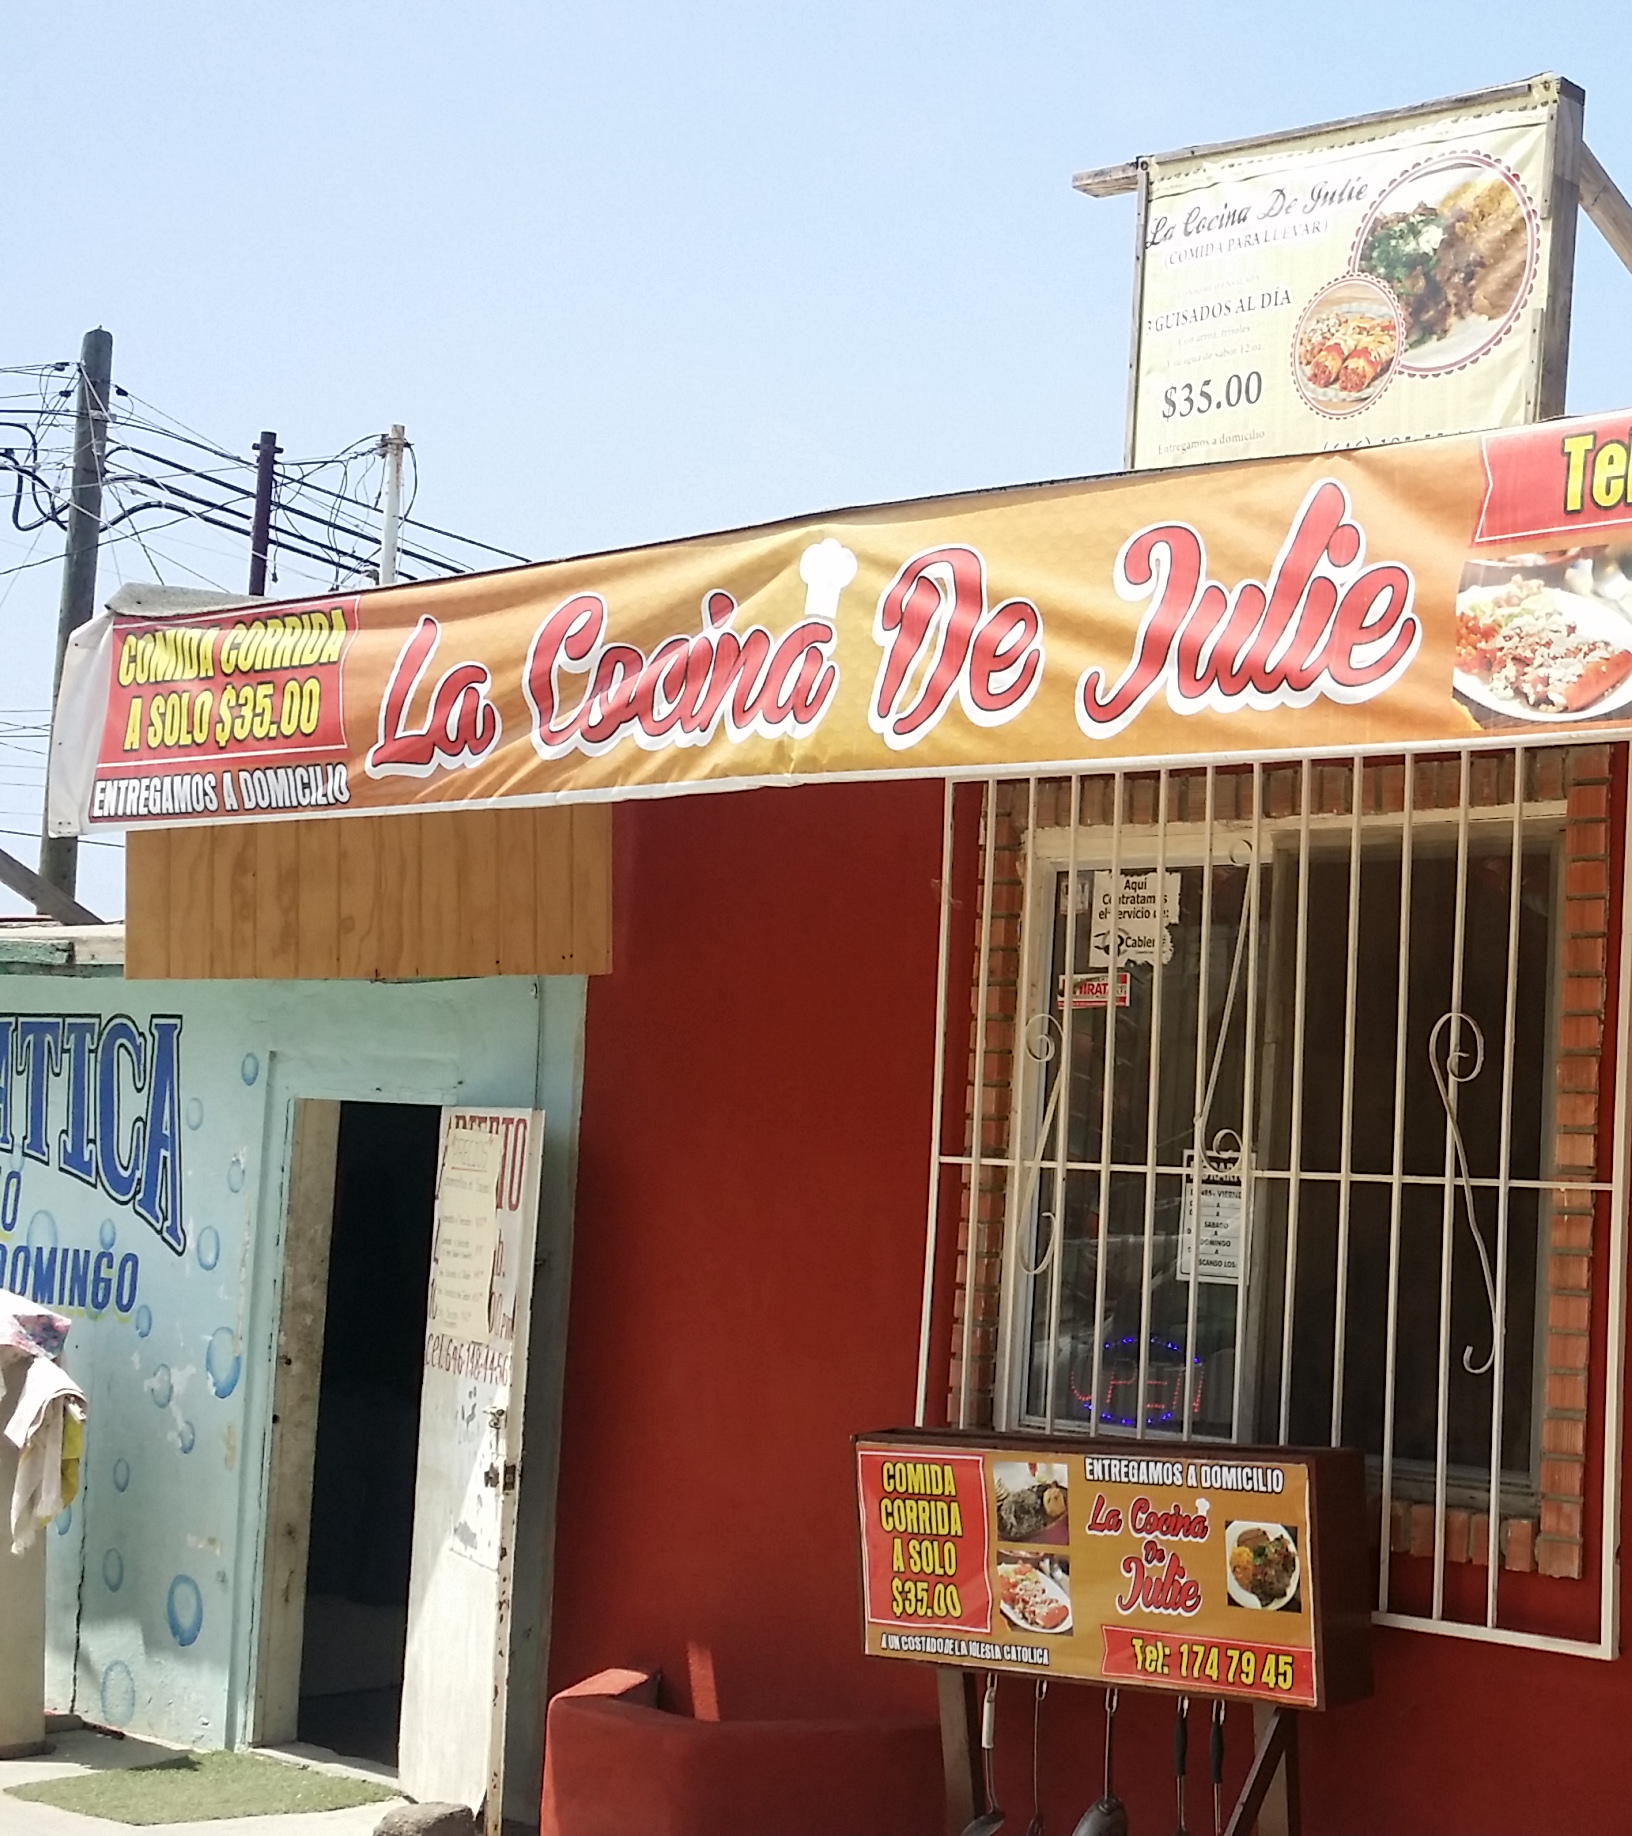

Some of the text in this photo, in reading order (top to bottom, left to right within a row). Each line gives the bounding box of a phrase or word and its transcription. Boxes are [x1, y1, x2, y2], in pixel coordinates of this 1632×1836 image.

[1145, 176, 1369, 249] La Cocina De Julie
[1227, 232, 1261, 252] PARA
[1155, 300, 1232, 332] GUISADOS
[1235, 296, 1256, 314] AL
[1260, 286, 1292, 309] DÍA
[1162, 371, 1263, 422] $35.00
[1219, 429, 1265, 445] domicilio
[117, 607, 348, 688] COMIDA CORRIDA
[365, 476, 1418, 779] La Cocina De Julie
[123, 677, 322, 751] A SOLO $35.00
[92, 762, 350, 818] ENTREGAMOS A DOMICILIO
[1124, 878, 1147, 892] Aquí
[1108, 907, 1151, 919] ervicio
[0, 1013, 186, 1256] TICA
[882, 1461, 956, 1497] COMIDA
[1085, 1457, 1284, 1494] ENTREGAMOS A DOMICILIO
[880, 1498, 963, 1537] CORRIDA
[1087, 1494, 1210, 1542] La Cocina
[892, 1537, 957, 1576] A SOLO
[1143, 1540, 1166, 1565] De
[891, 1577, 963, 1618] $35.00
[1117, 1552, 1202, 1616] Julie
[881, 1632, 887, 1649] A
[888, 1635, 900, 1650] UN
[901, 1635, 944, 1654] COSTADO
[955, 1640, 968, 1656] LA
[969, 1641, 1002, 1660] IGLESIA
[1003, 1644, 1050, 1666] CATOLICA
[1131, 1637, 1294, 1691] Tel: 174 79 45
